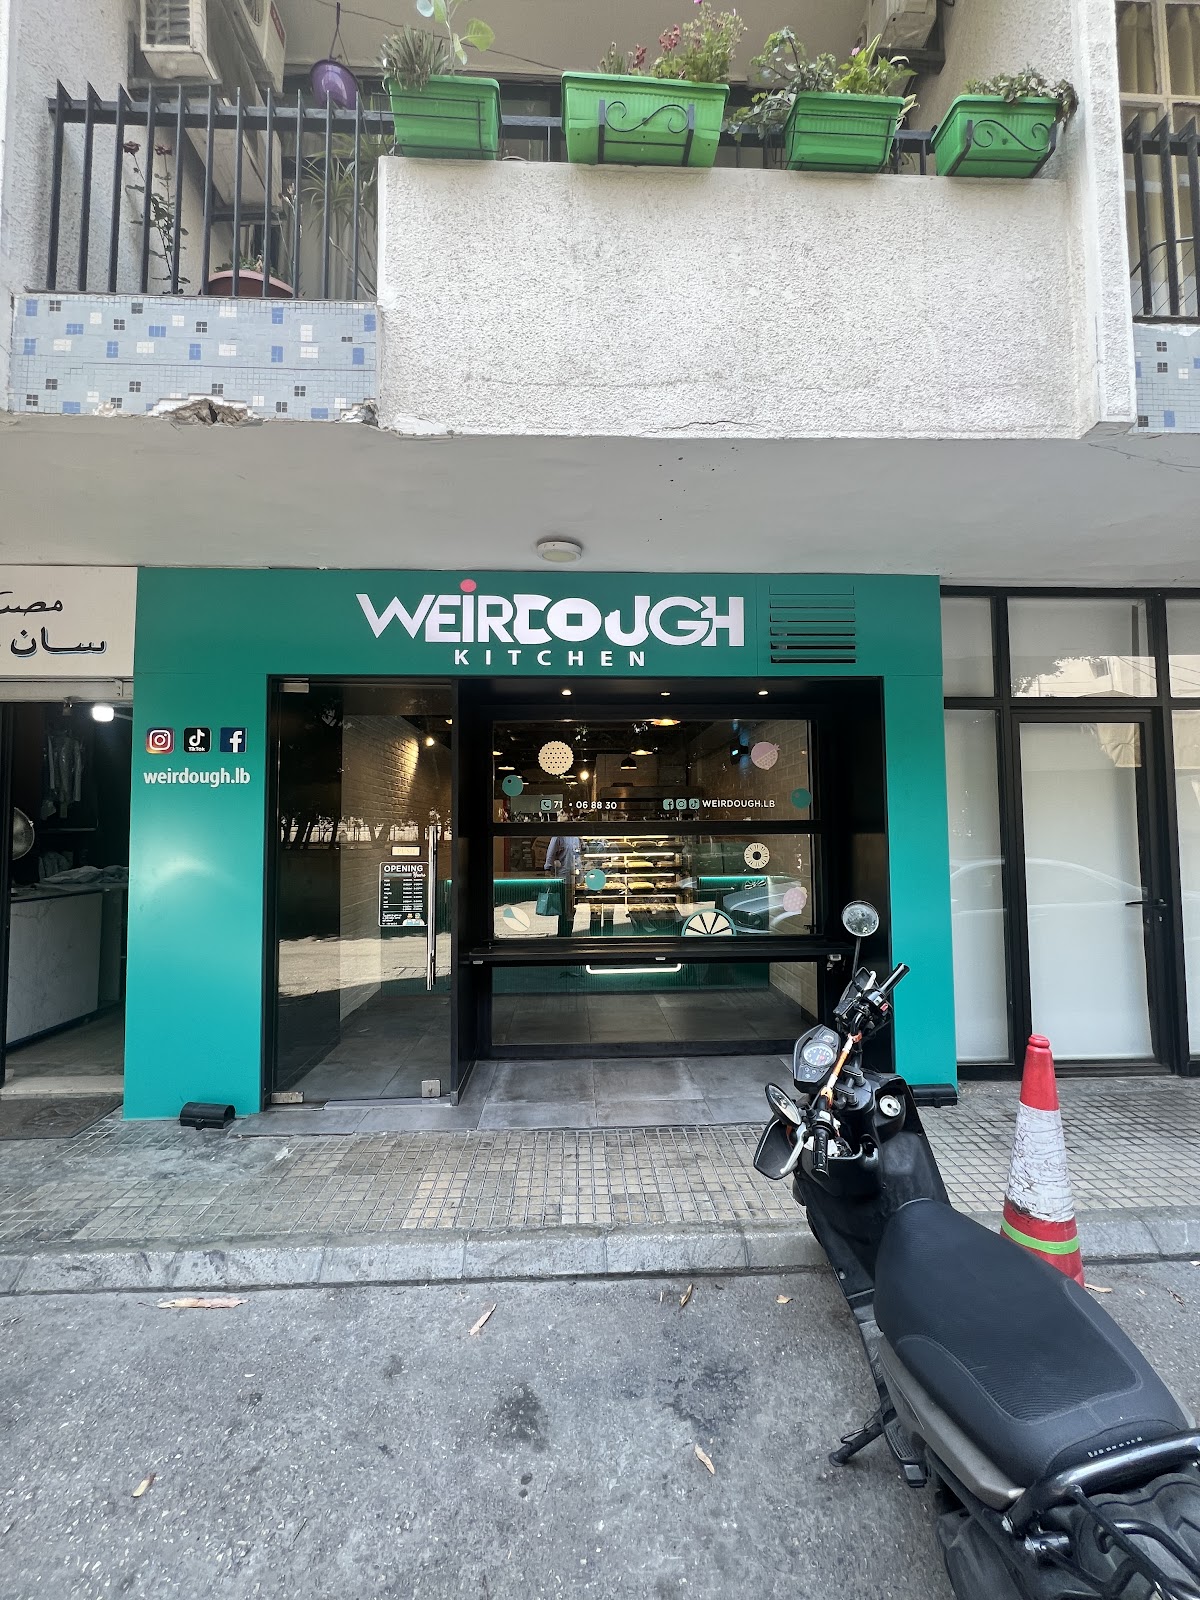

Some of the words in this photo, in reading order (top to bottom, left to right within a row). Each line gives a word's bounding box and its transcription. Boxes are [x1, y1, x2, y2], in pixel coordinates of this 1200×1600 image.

[454, 649, 646, 667] KITCHEN
[143, 767, 251, 788] weirdough.lb
[575, 800, 588, 809] 06
[591, 801, 603, 810] 88
[605, 801, 617, 810] 30
[701, 799, 776, 808] WEIRDOUGH.LB
